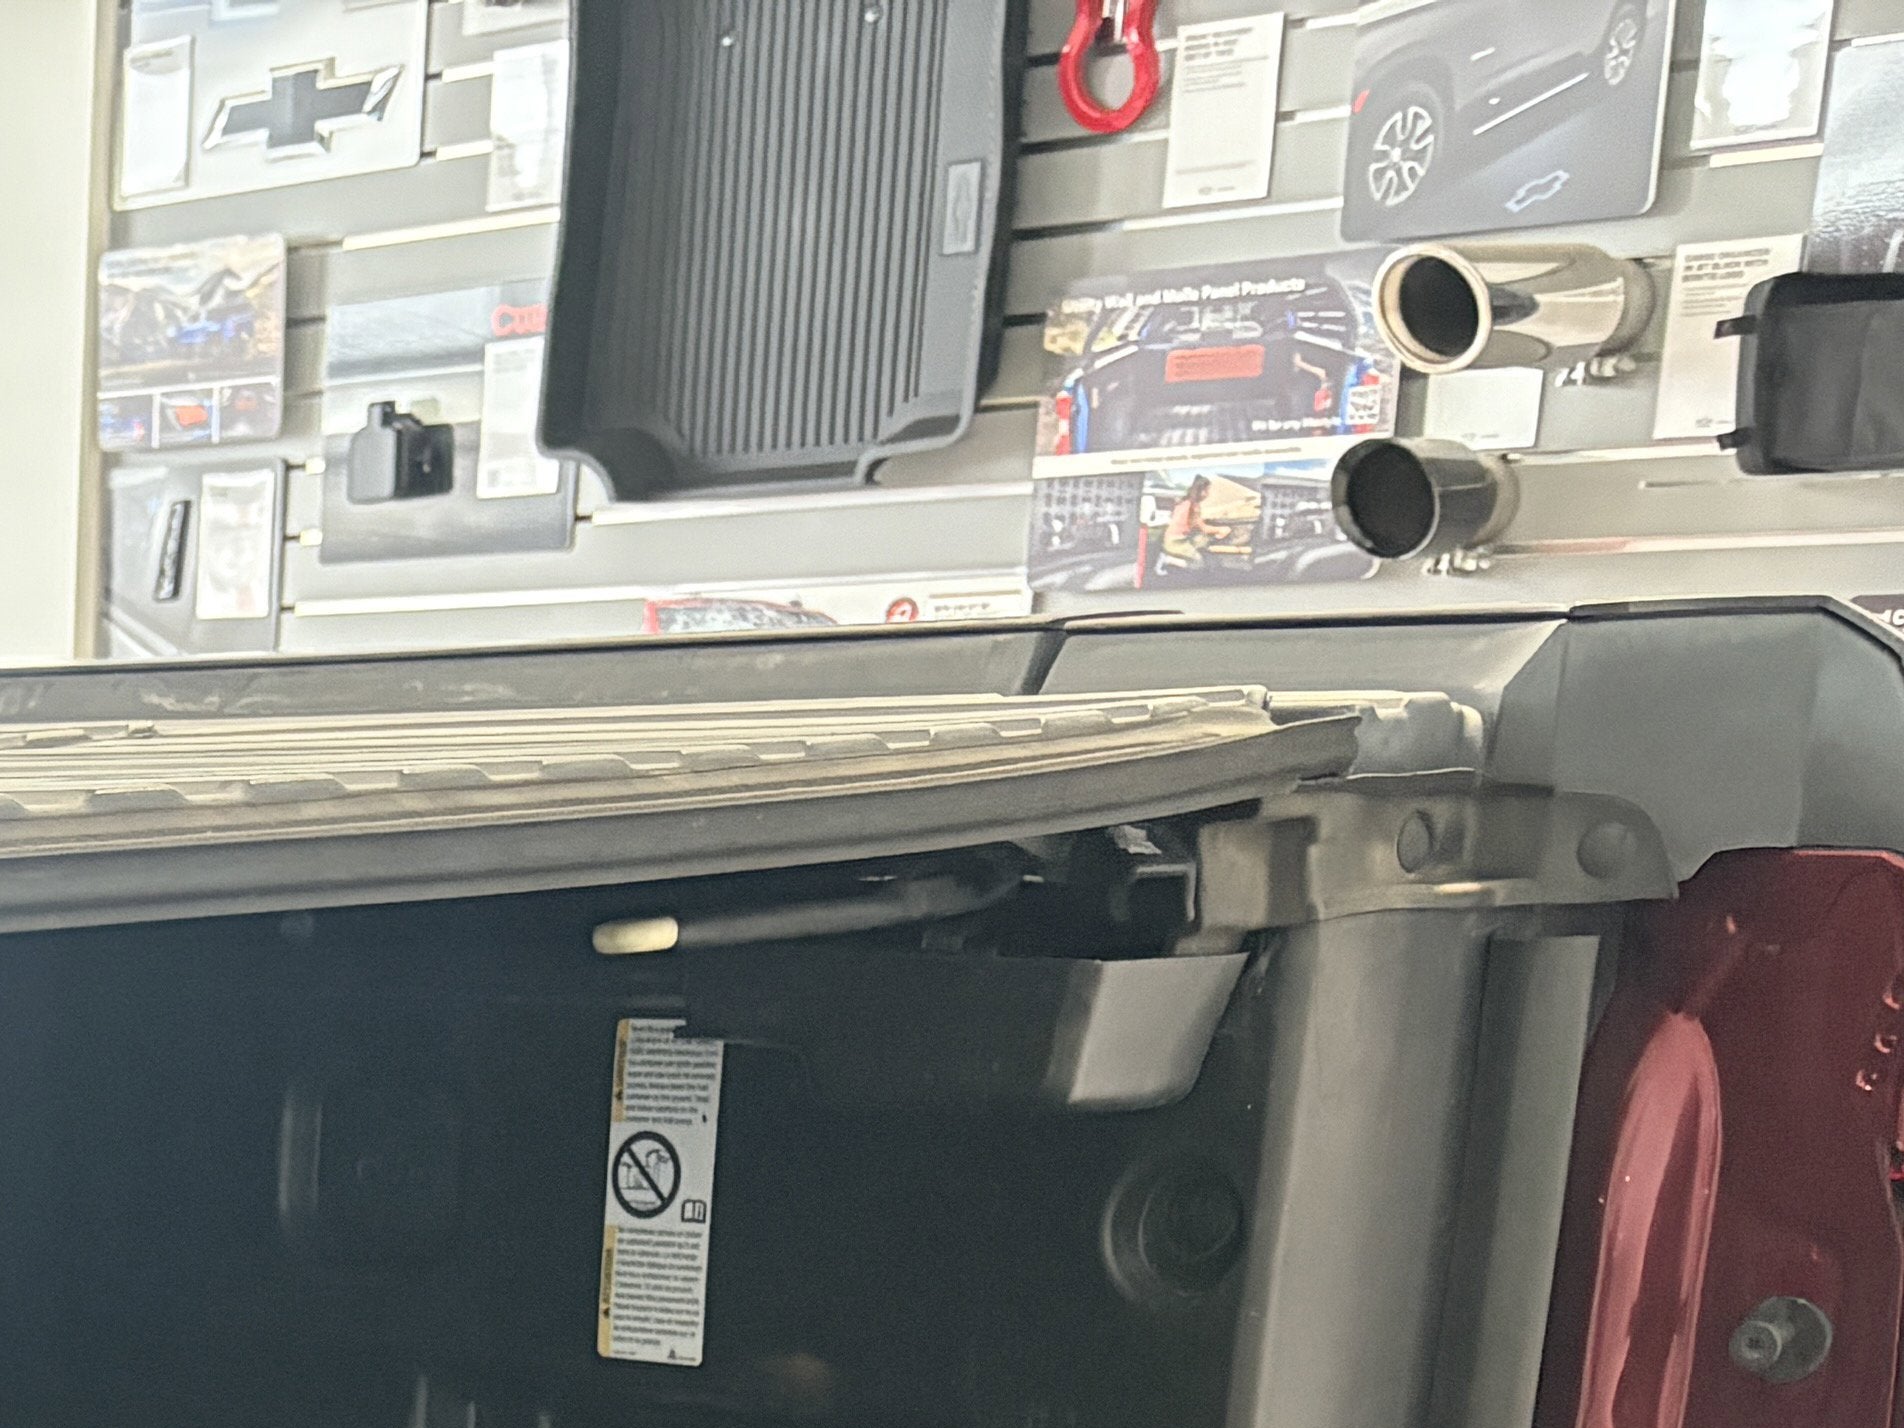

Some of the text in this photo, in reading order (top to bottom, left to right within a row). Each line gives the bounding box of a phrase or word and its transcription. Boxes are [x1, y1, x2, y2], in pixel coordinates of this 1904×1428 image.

[1136, 290, 1162, 306] and
[1201, 282, 1240, 300] Panel
[1241, 278, 1306, 296] Products
